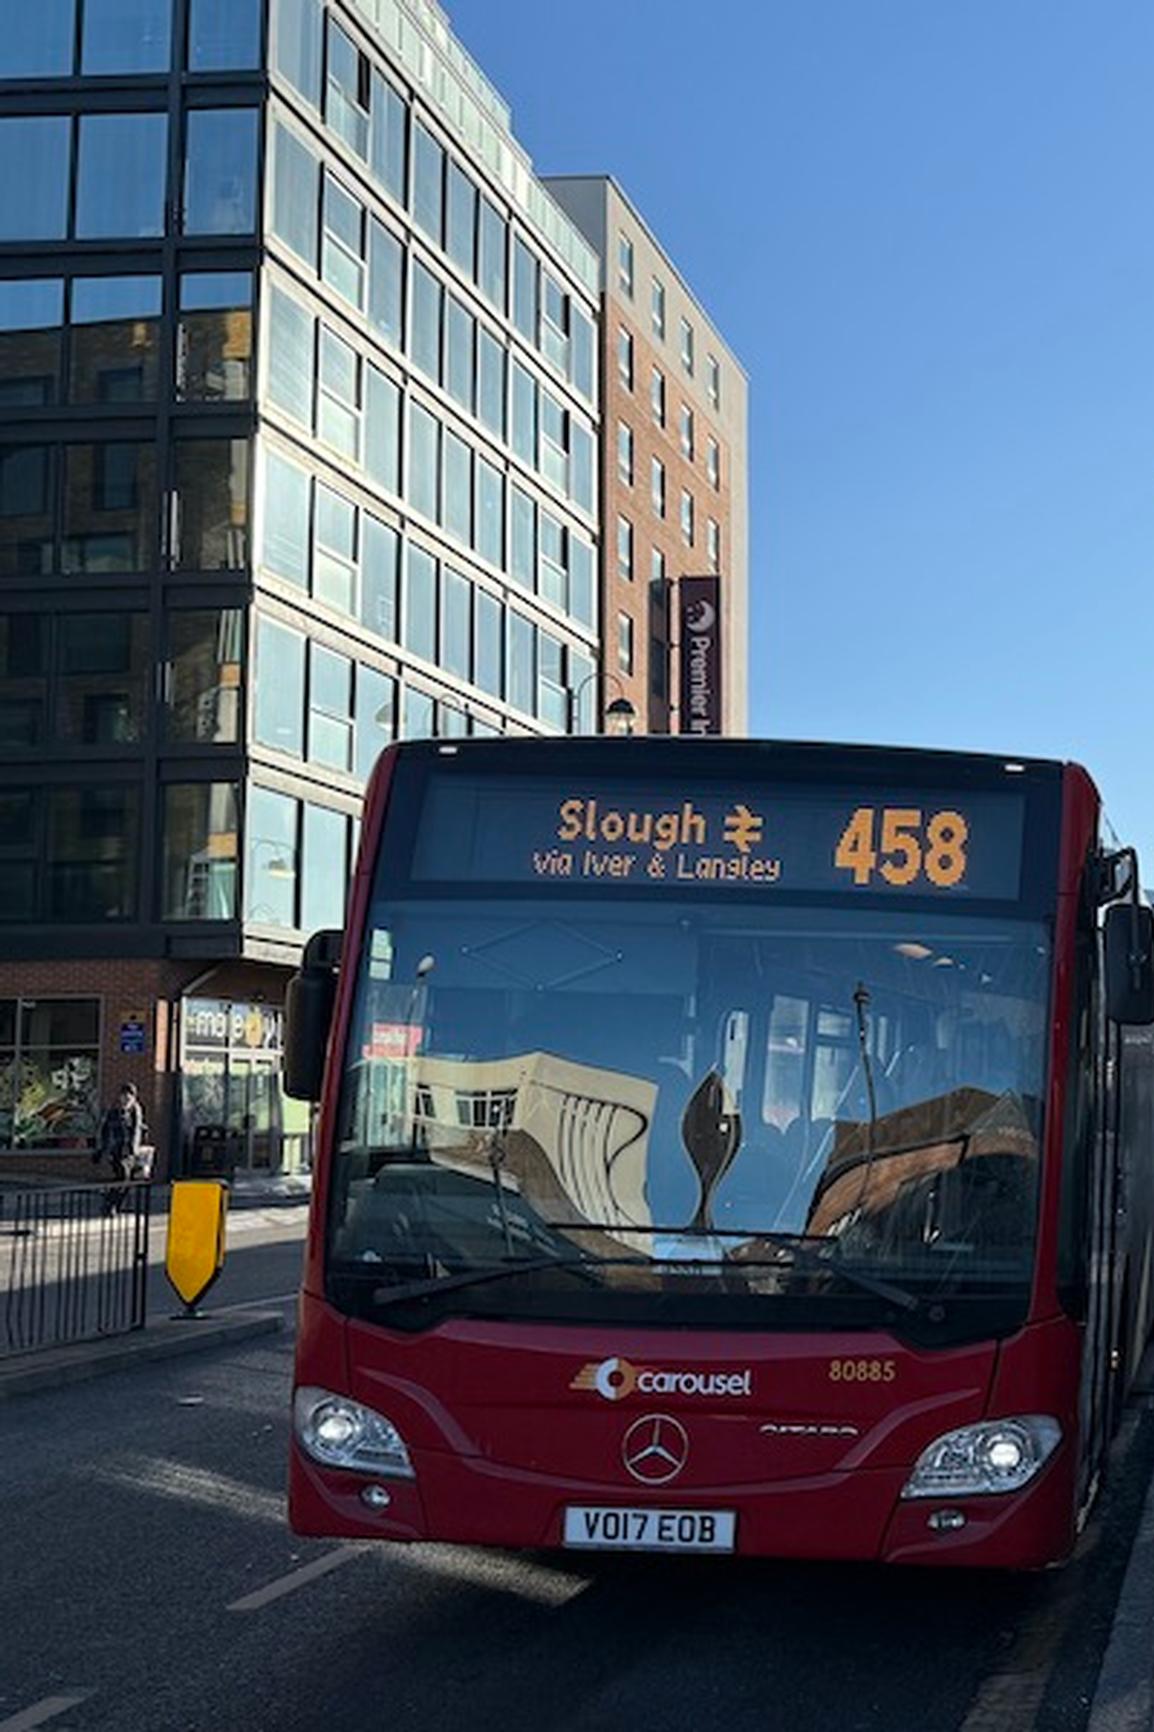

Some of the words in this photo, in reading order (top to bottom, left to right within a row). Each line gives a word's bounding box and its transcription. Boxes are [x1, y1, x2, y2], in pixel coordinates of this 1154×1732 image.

[690, 636, 711, 716] Premier
[557, 800, 706, 851] Slough
[835, 808, 969, 887] 458
[533, 850, 571, 877] via
[582, 851, 636, 877] Iver
[648, 854, 666, 878] &
[676, 855, 781, 882] Langley
[637, 1369, 752, 1396] carousel
[828, 1360, 896, 1383] 80885
[584, 1511, 648, 1540] VO17
[657, 1513, 716, 1543] EOB
